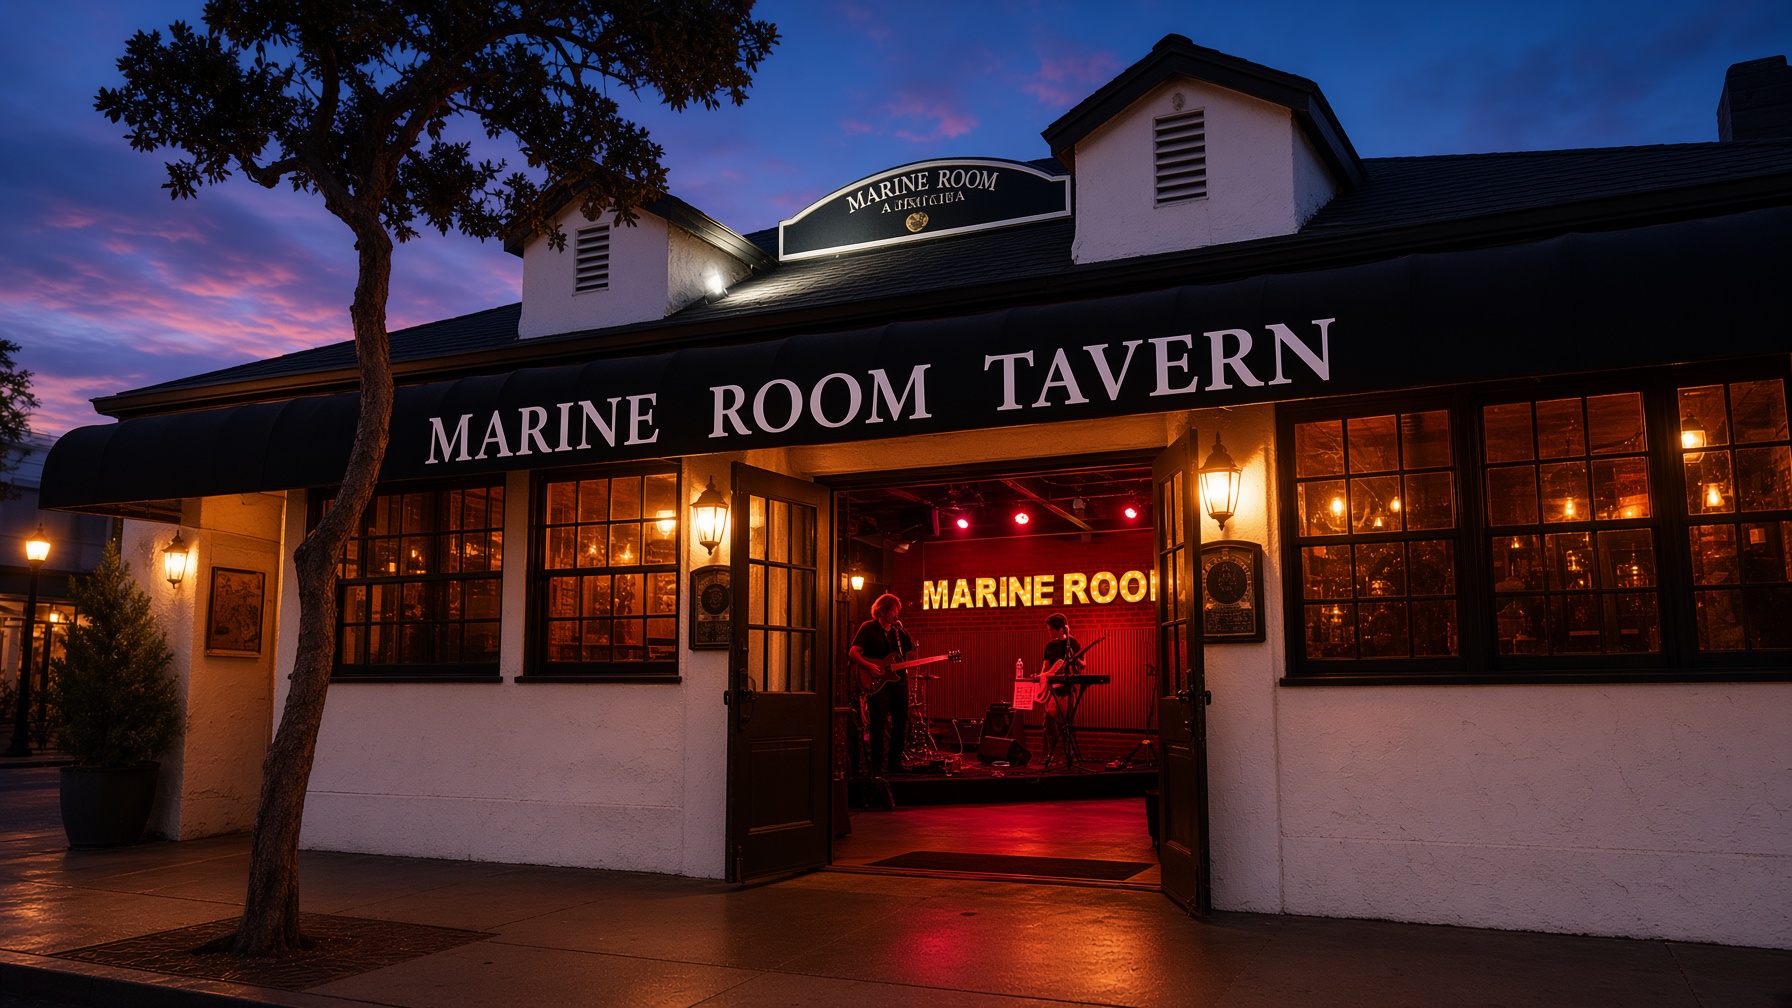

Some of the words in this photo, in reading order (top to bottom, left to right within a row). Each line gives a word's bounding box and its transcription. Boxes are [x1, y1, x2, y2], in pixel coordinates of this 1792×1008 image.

[846, 171, 929, 213] MARINE
[937, 168, 999, 191] ROOM
[424, 392, 659, 465] MARINE
[708, 363, 932, 439] ROOM
[983, 317, 1336, 412] TAVERN
[923, 574, 1054, 610] MARINE
[1063, 570, 1156, 605] ROO
